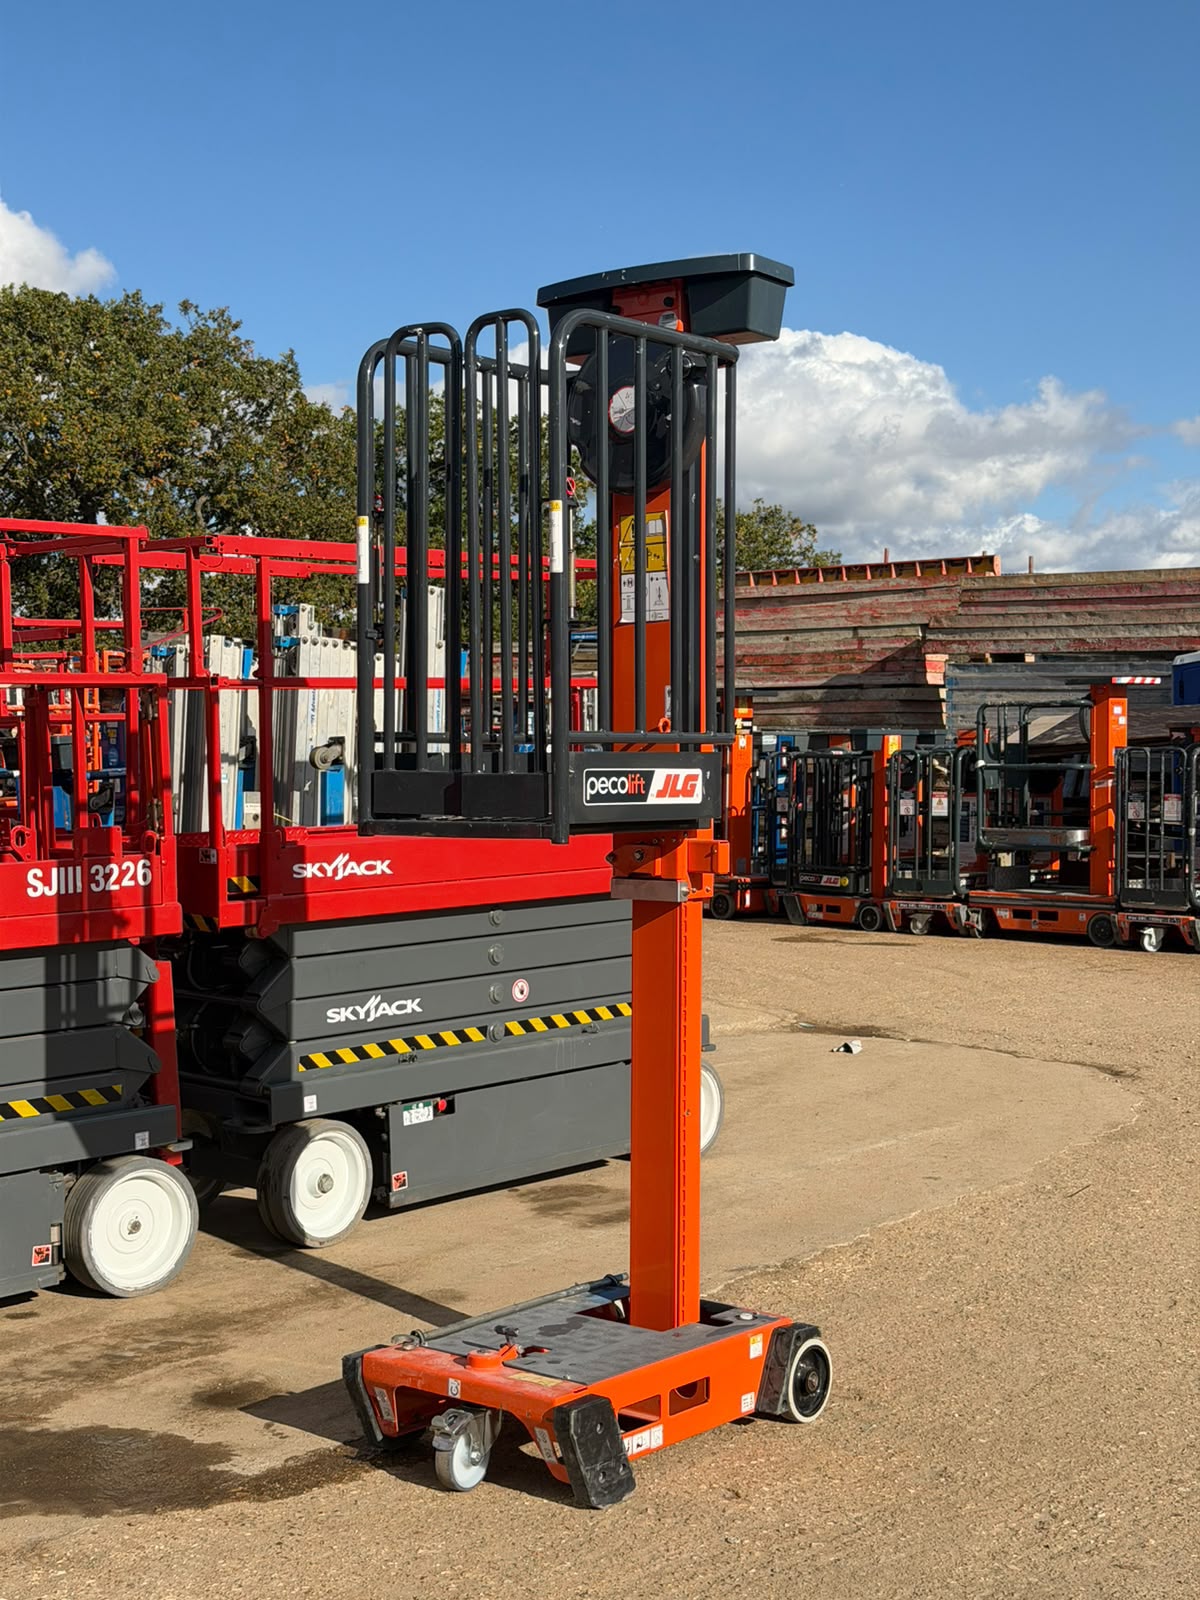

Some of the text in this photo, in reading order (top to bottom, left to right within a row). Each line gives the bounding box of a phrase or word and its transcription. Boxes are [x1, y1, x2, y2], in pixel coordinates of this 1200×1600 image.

[586, 773, 700, 801] pecolift JLG
[26, 858, 152, 898] SJIII 3226
[292, 852, 394, 881] SKYJACK
[326, 994, 423, 1023] SKYJACK
